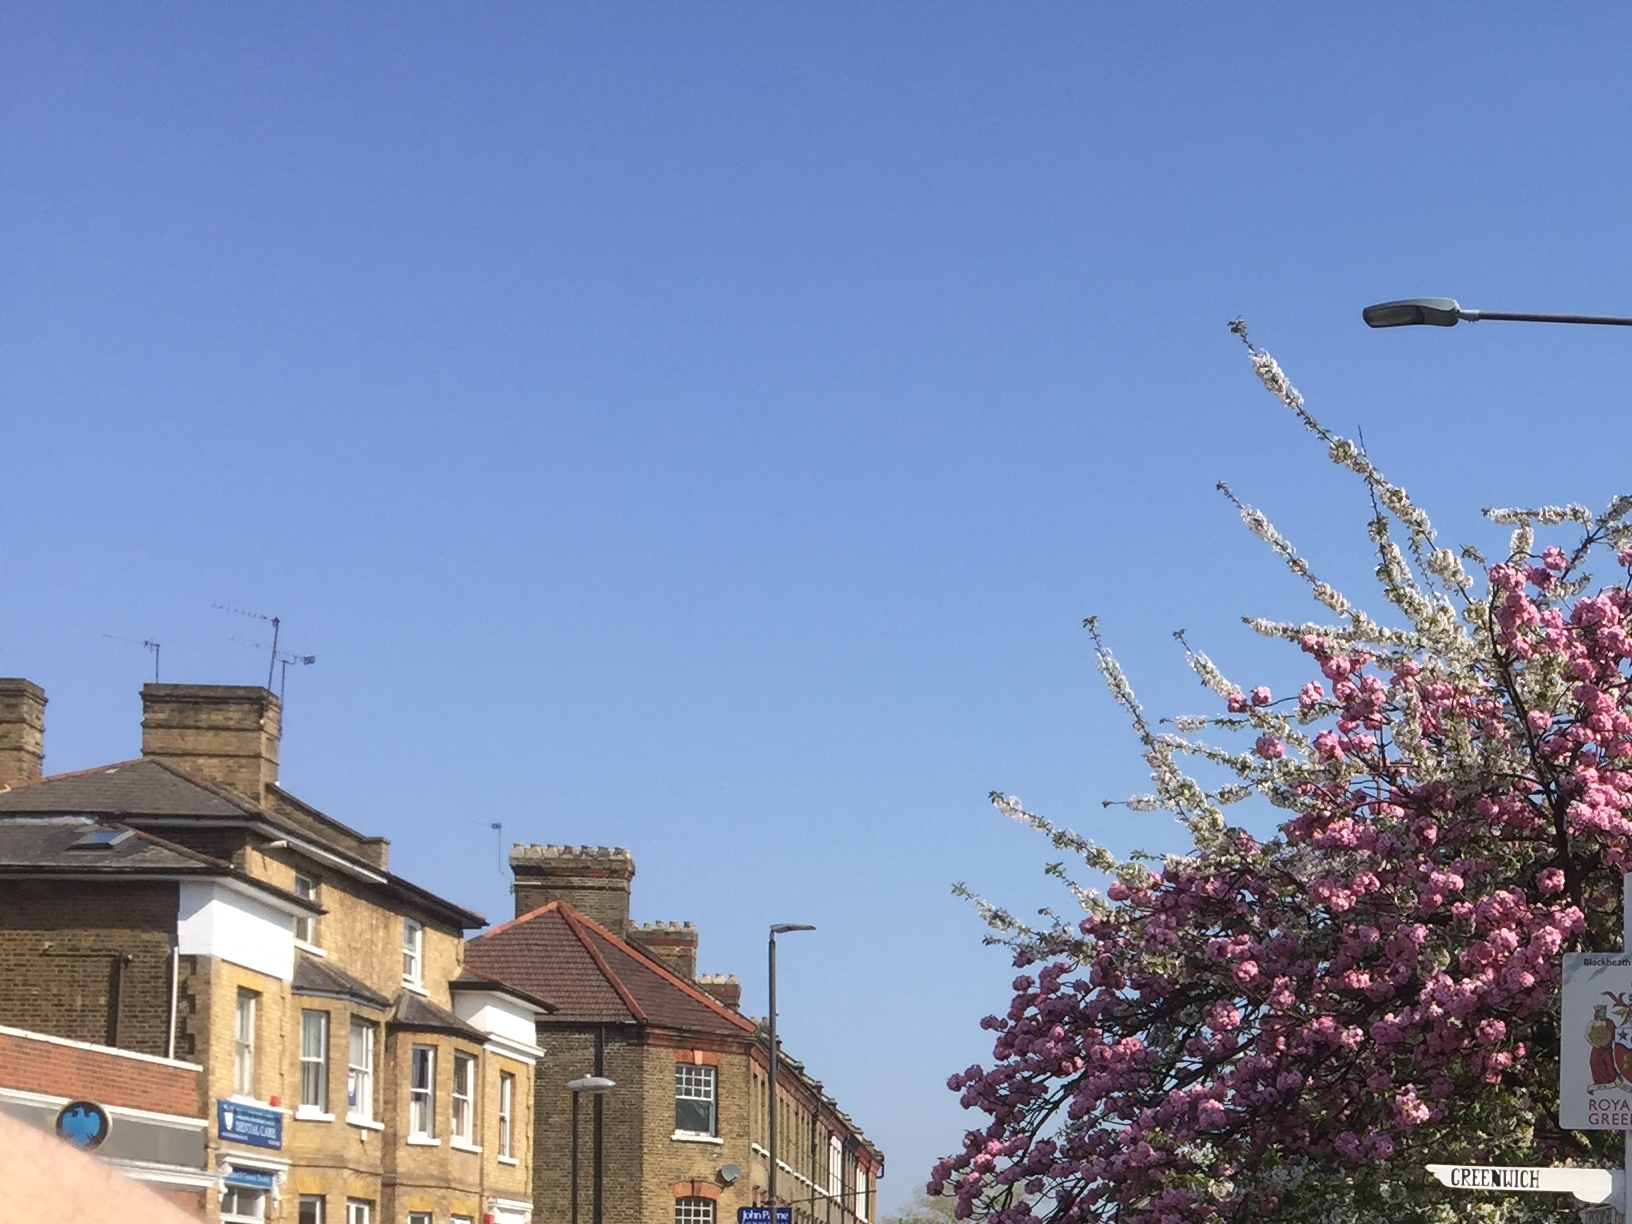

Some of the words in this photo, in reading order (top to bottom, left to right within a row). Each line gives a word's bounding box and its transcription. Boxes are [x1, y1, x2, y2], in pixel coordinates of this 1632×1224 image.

[1583, 958, 1631, 967] Blackheath
[1451, 1168, 1540, 1188] GREENWICH
[742, 1210, 762, 1221] John
[762, 1210, 789, 1220] Pne
